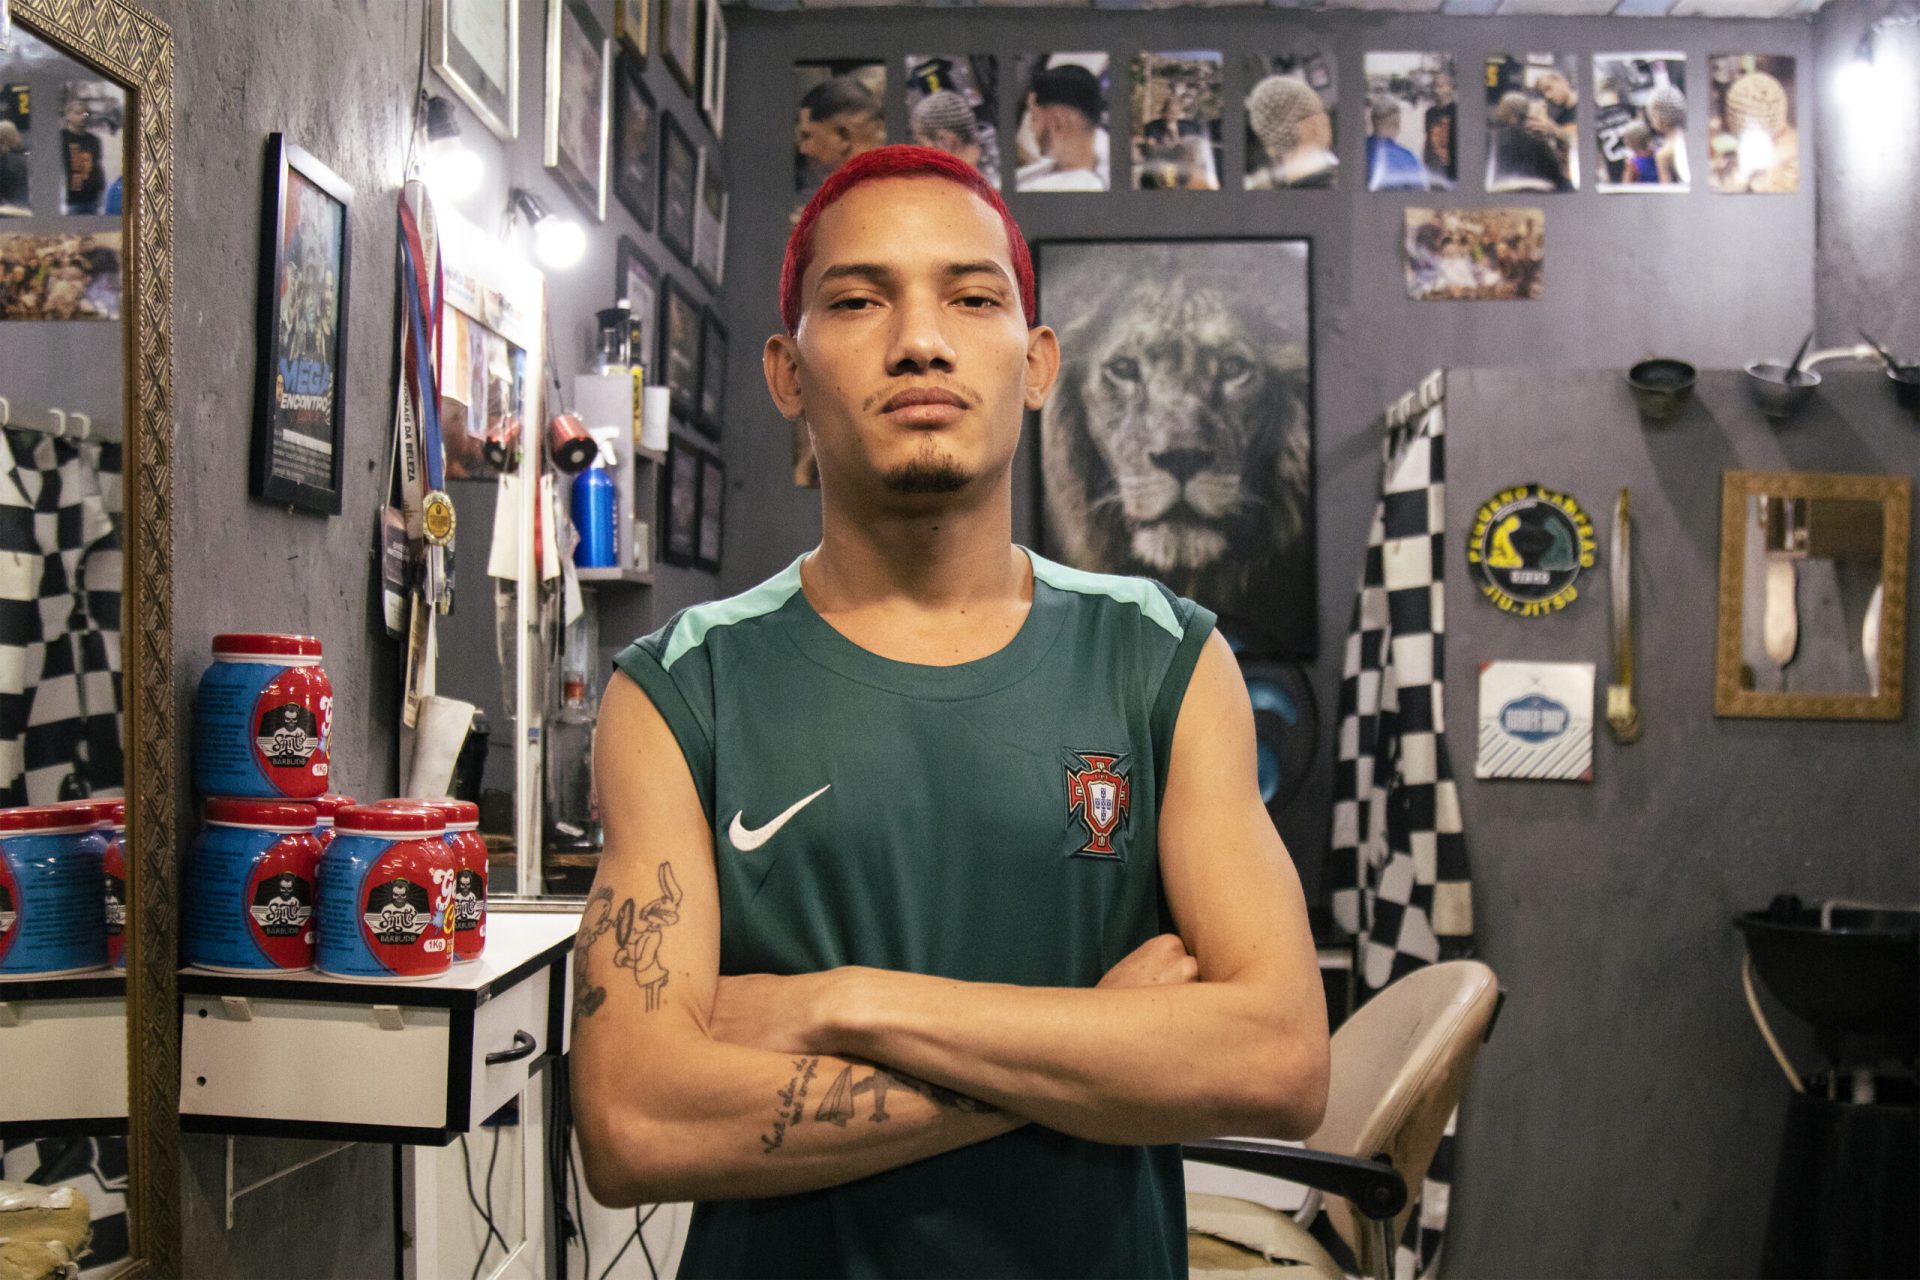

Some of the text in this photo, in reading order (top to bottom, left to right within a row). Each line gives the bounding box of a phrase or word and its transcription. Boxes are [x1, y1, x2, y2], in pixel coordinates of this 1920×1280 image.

[279, 358, 331, 397] MEGA
[280, 392, 330, 413] ENCONTRO
[404, 426, 413, 440] DA
[405, 441, 416, 482] BELEZA
[1481, 584, 1578, 617] JIU-JITSU
[428, 940, 444, 951] 1Kg
